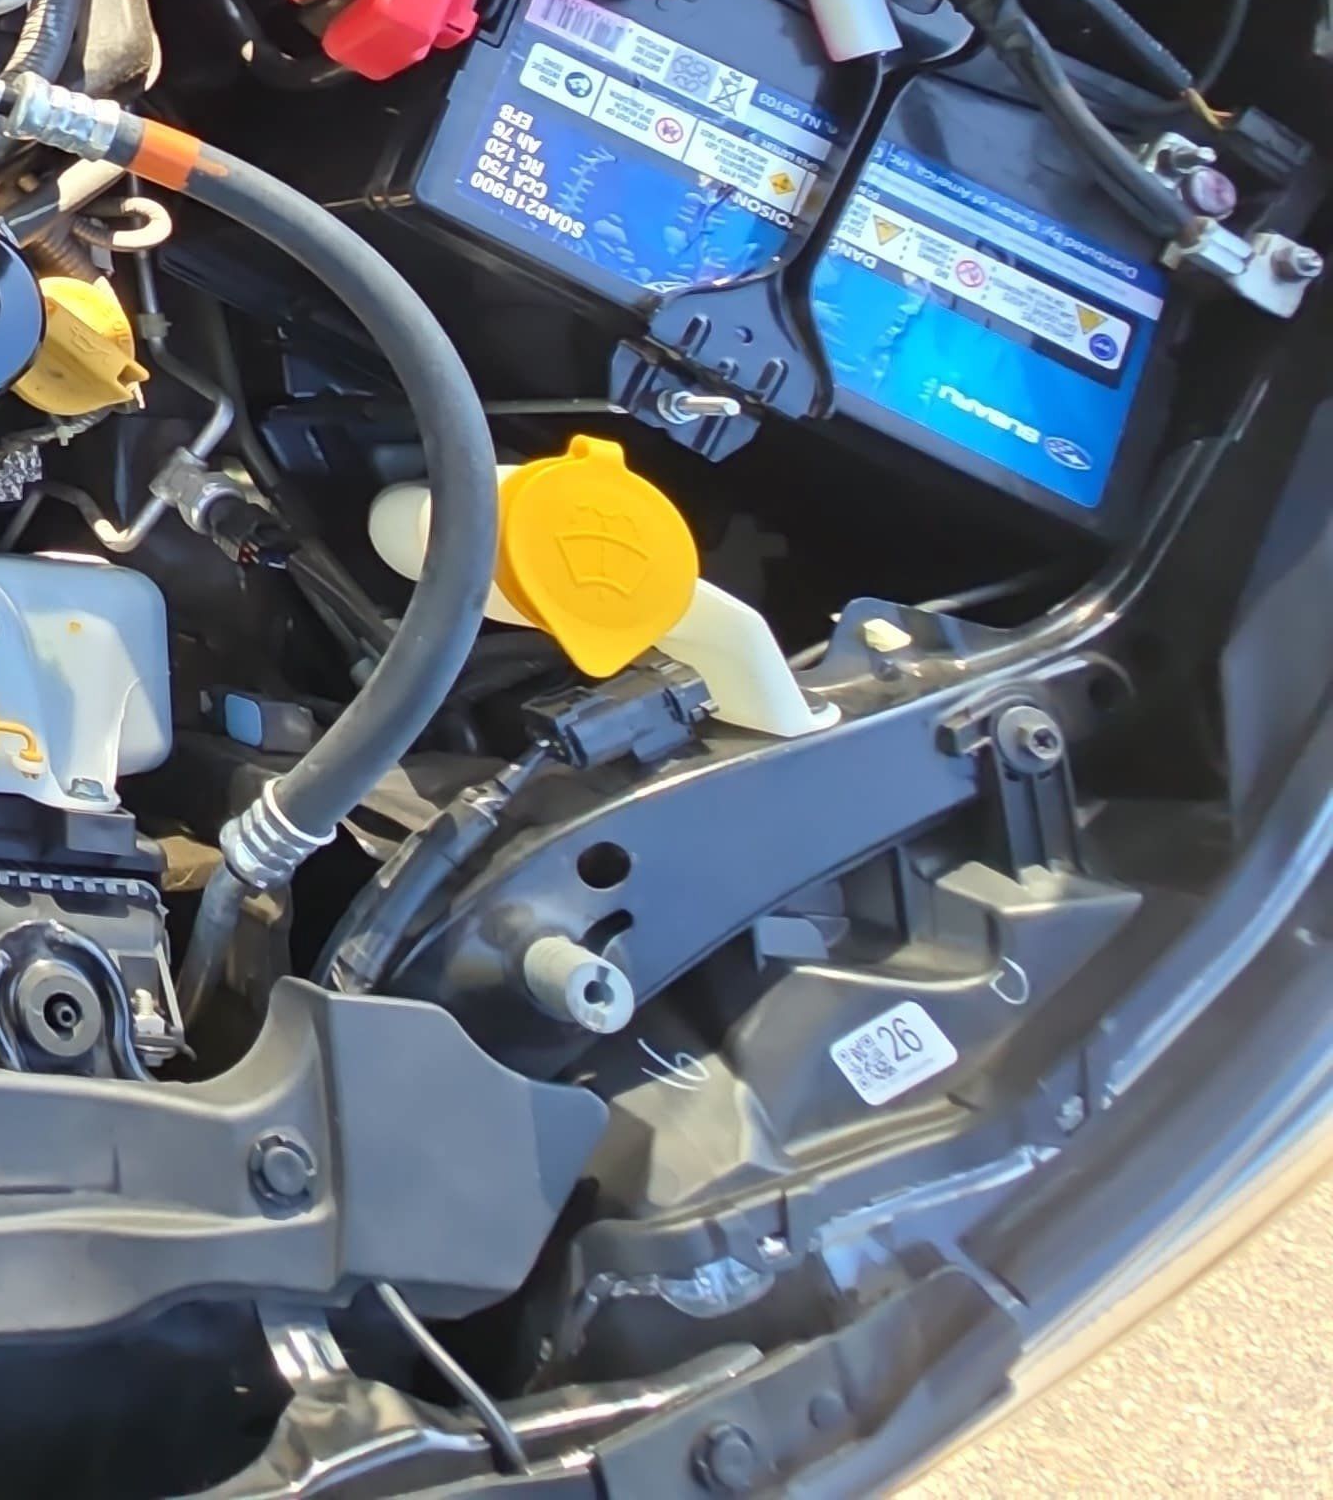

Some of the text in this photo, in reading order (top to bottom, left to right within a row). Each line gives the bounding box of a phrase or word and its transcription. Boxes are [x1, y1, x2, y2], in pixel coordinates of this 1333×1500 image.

[491, 119, 543, 156] Ah 76
[499, 102, 535, 131] EFB
[478, 153, 549, 200] CCA 750
[485, 136, 546, 177] RC 120
[937, 383, 1041, 444] SUBARU
[876, 1016, 923, 1062] 26
